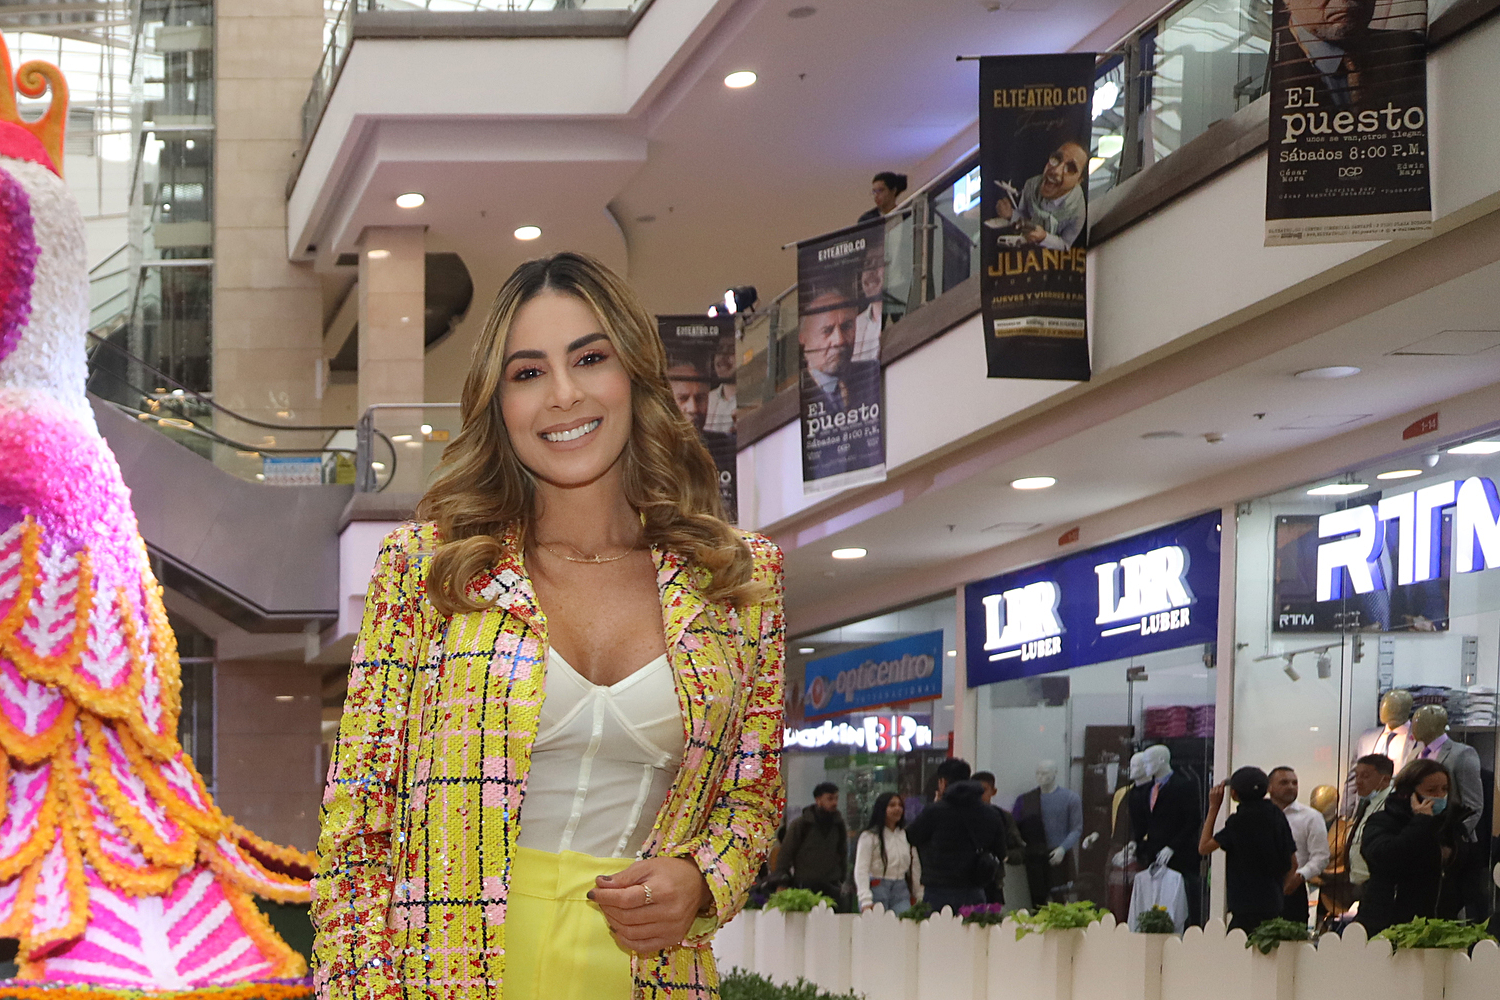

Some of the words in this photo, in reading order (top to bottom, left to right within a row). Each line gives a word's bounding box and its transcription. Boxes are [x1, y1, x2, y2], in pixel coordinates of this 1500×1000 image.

[993, 86, 1088, 108] ELTEATRO.CO
[1284, 86, 1319, 109] El
[1281, 102, 1425, 144] puesto
[1280, 148, 1343, 163] Sábados
[1349, 145, 1387, 160] 8:00
[1391, 143, 1425, 157] P.M.
[1338, 166, 1363, 178] DGP
[1396, 162, 1425, 170] Edwin
[806, 402, 879, 439] puesto
[807, 401, 826, 418] El
[1141, 607, 1190, 636] LUBER
[1279, 614, 1315, 628] RTM
[1021, 636, 1062, 662] LUBER
[836, 653, 935, 703] opticentro
